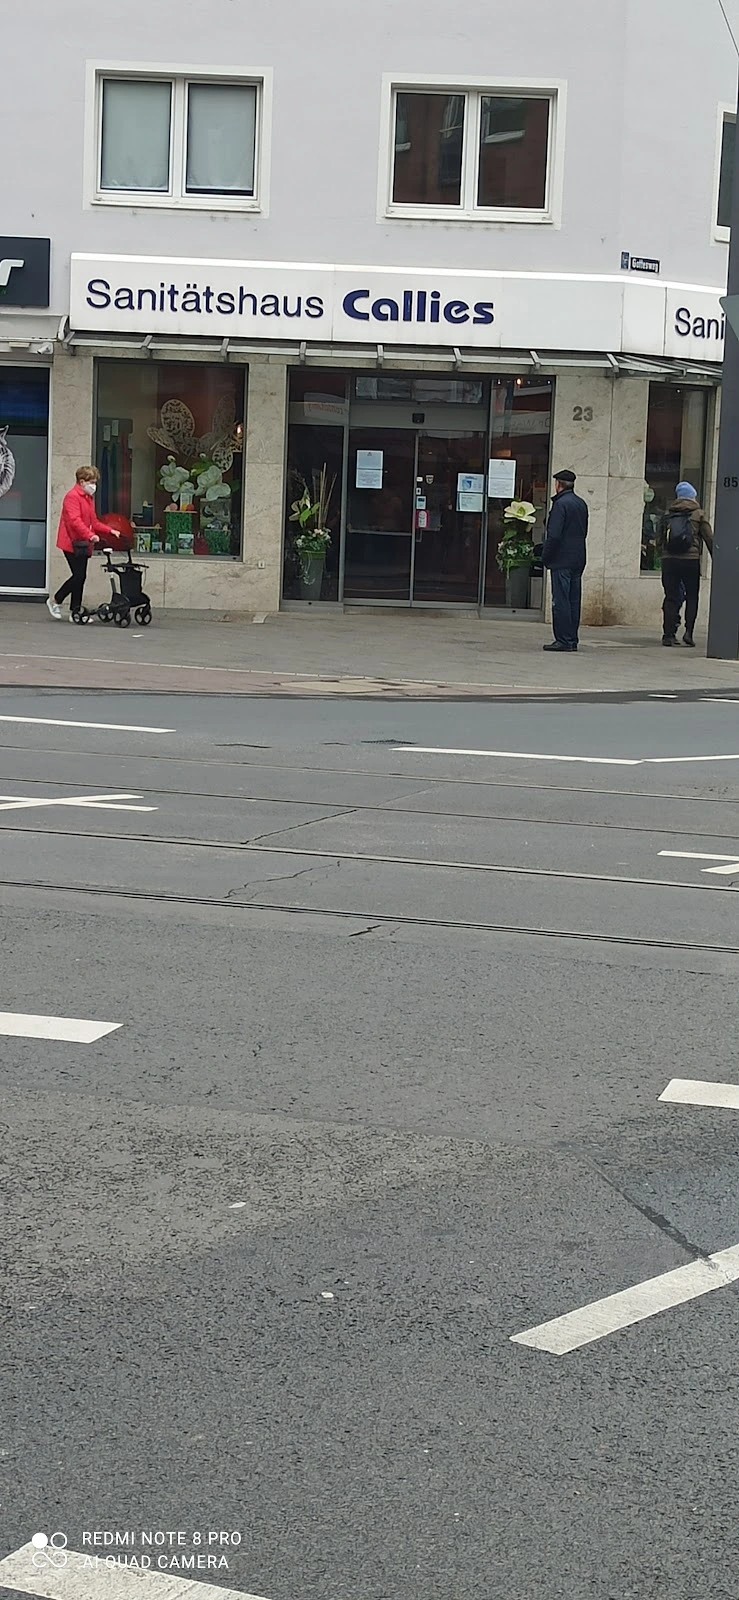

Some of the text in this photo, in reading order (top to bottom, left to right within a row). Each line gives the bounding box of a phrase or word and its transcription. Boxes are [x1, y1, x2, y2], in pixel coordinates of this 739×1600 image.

[85, 279, 495, 325] Sanitätshaus Callies
[572, 406, 594, 422] 23
[723, 476, 739, 488] 85
